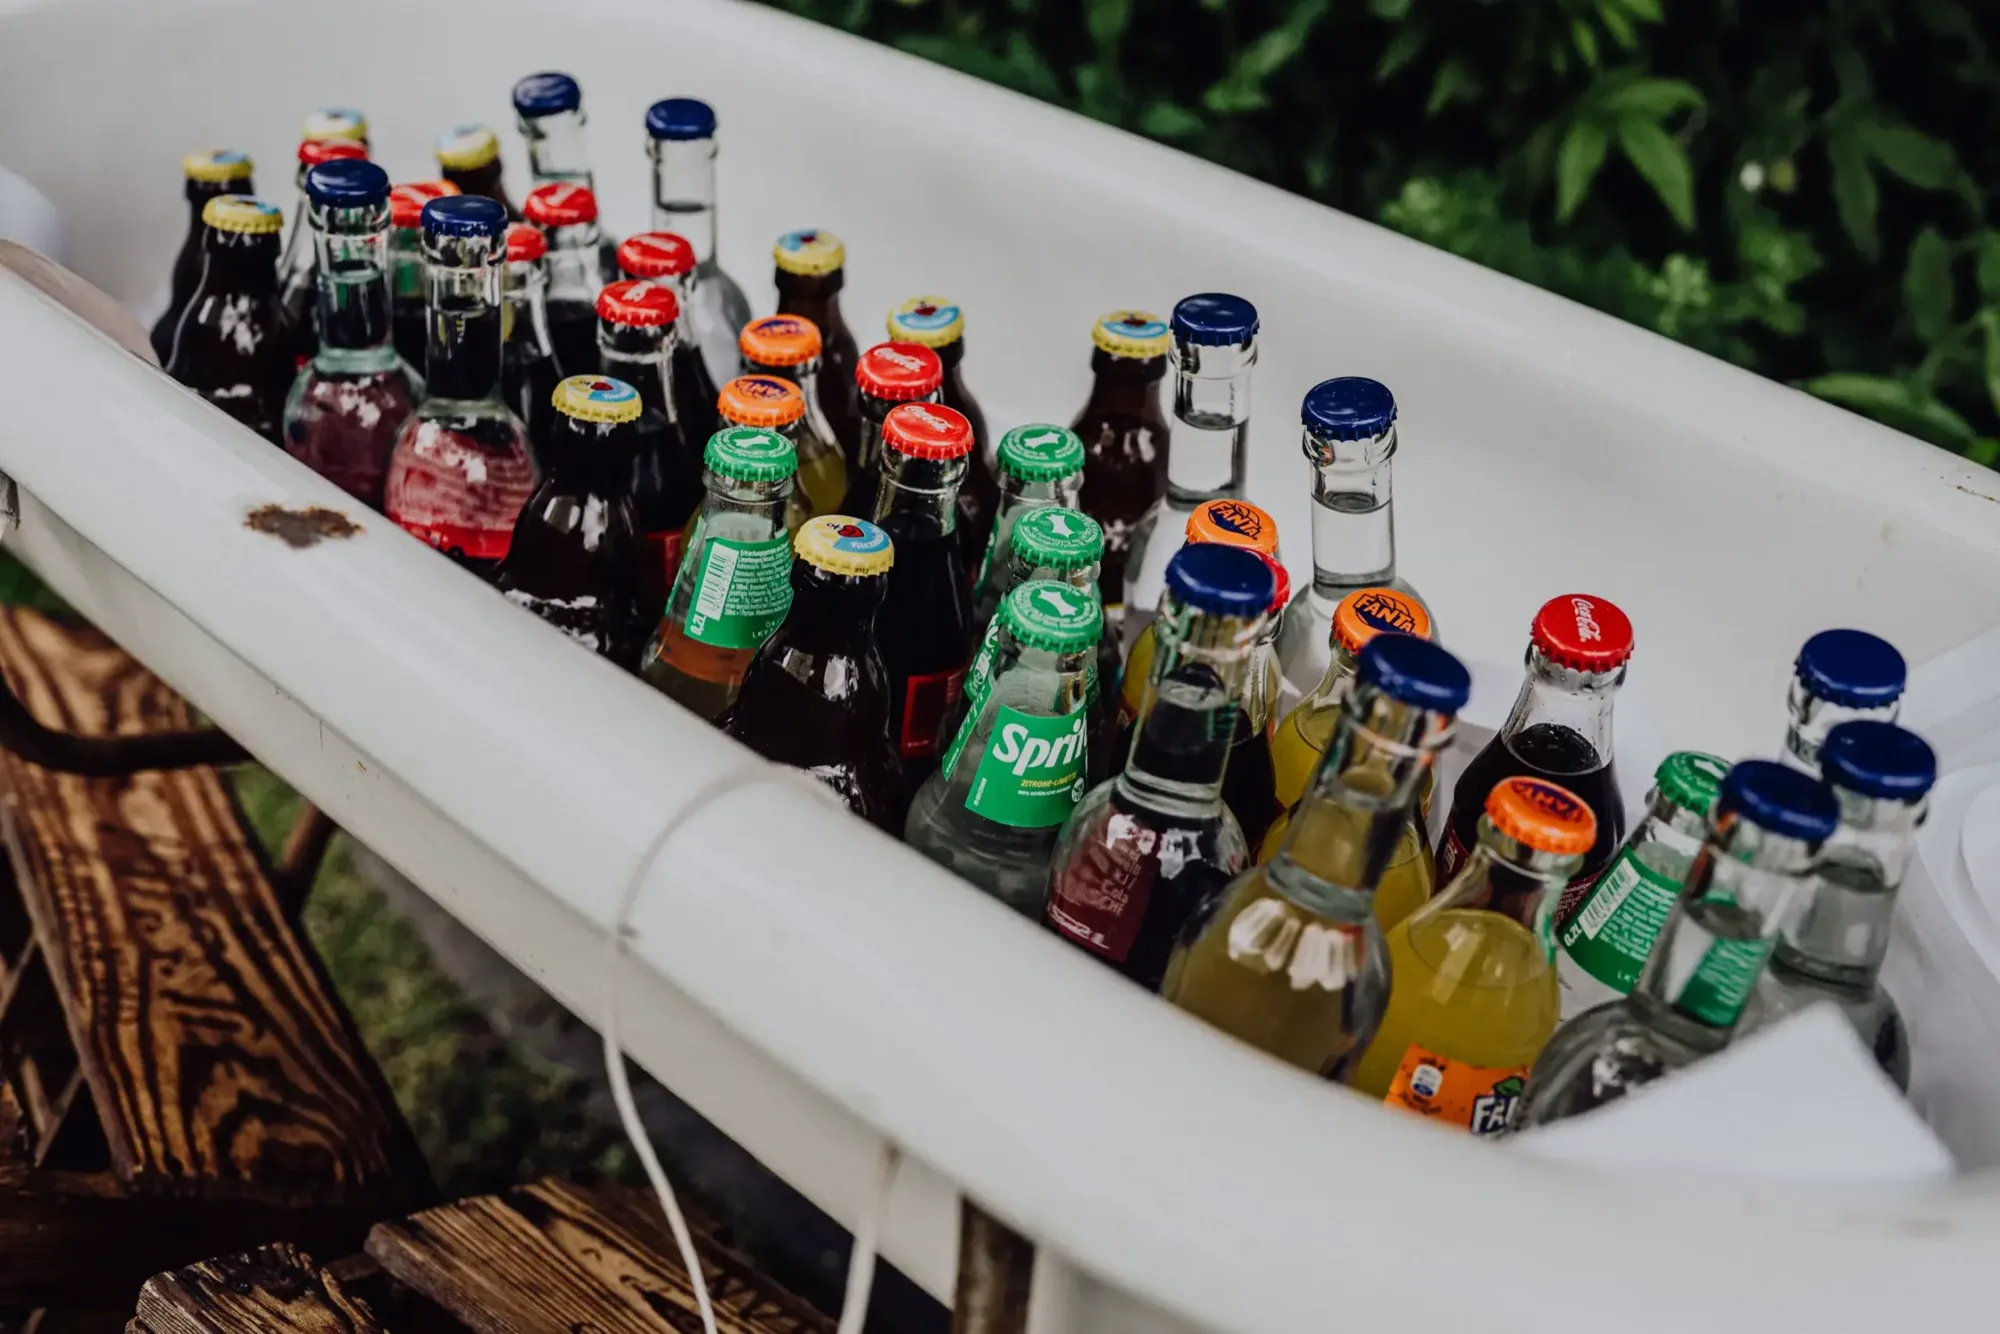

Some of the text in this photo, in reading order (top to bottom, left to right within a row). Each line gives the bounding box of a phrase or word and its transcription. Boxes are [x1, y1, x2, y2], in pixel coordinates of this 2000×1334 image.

[1209, 500, 1262, 539] FANTA
[1355, 595, 1417, 633] FANTA
[1571, 598, 1602, 643] Coca-Cola
